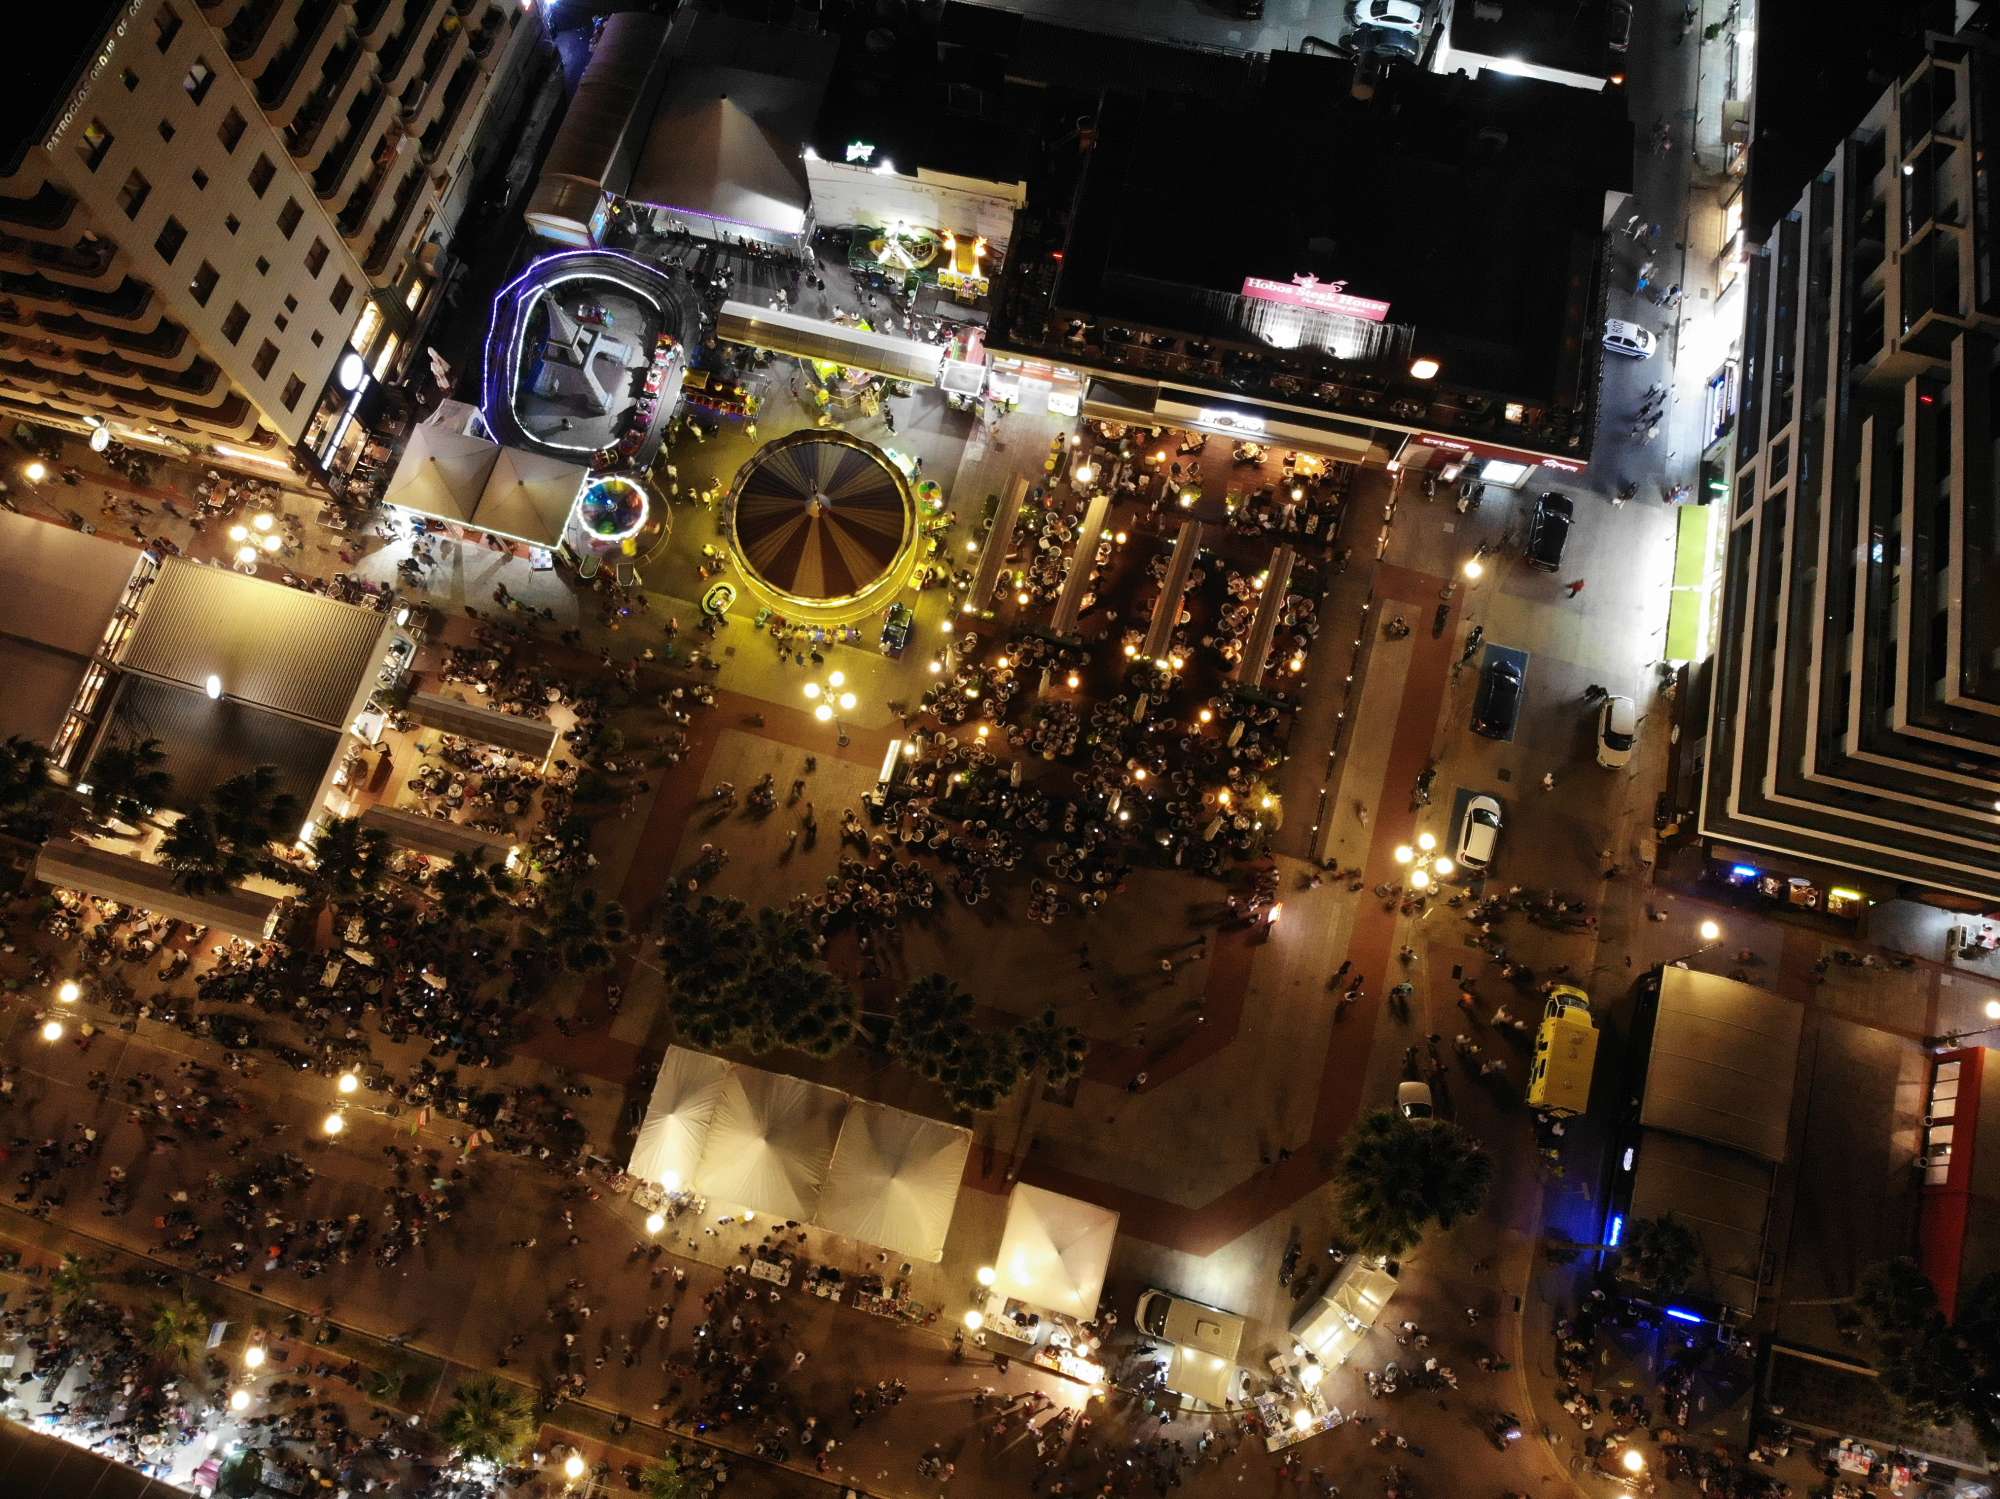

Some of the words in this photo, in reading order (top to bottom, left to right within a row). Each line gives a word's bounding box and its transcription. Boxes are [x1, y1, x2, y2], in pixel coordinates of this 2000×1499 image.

[46, 82, 91, 152] PATROCLOS
[117, 18, 127, 37] OF
[129, 0, 144, 17] CO
[1248, 278, 1293, 295] Hobos
[1296, 286, 1336, 302] Steak
[1338, 293, 1387, 312] House
